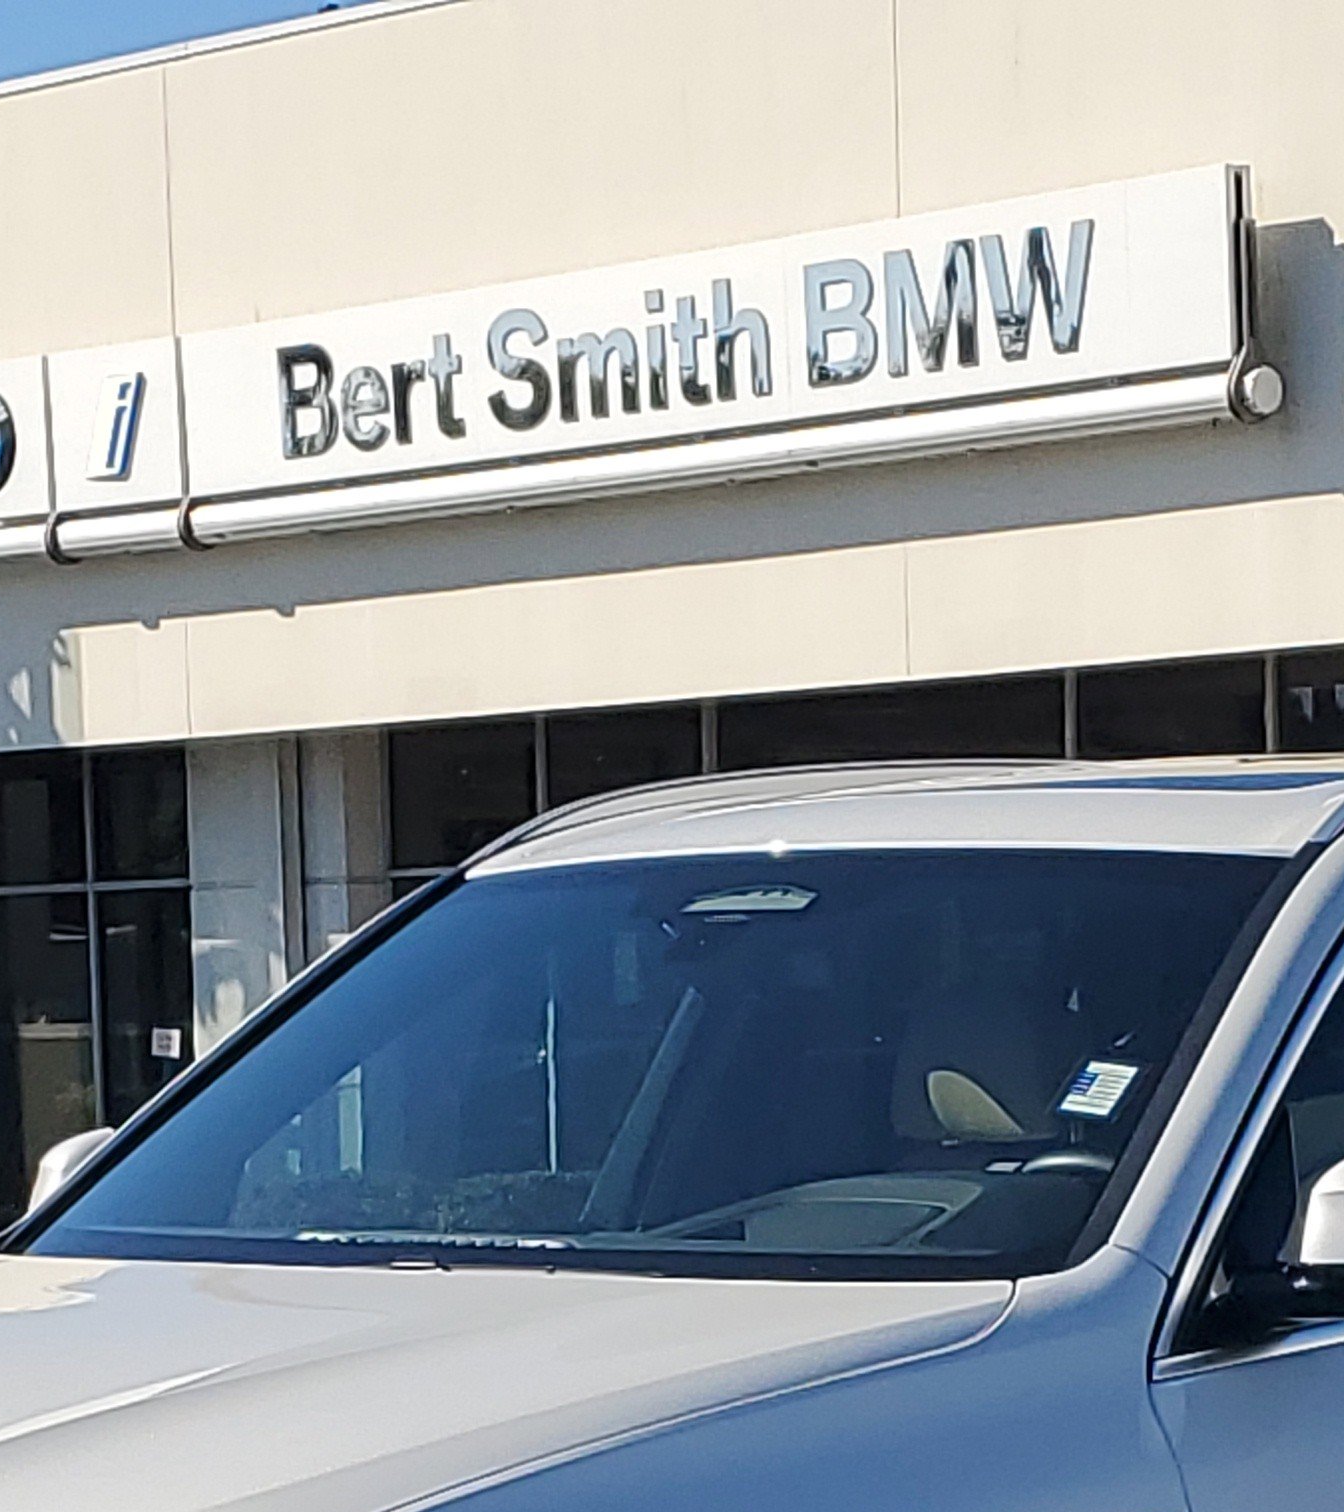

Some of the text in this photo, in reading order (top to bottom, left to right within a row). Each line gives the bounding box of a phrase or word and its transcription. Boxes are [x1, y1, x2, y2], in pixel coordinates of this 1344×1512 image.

[275, 218, 1094, 460] Bert Smith BMW
